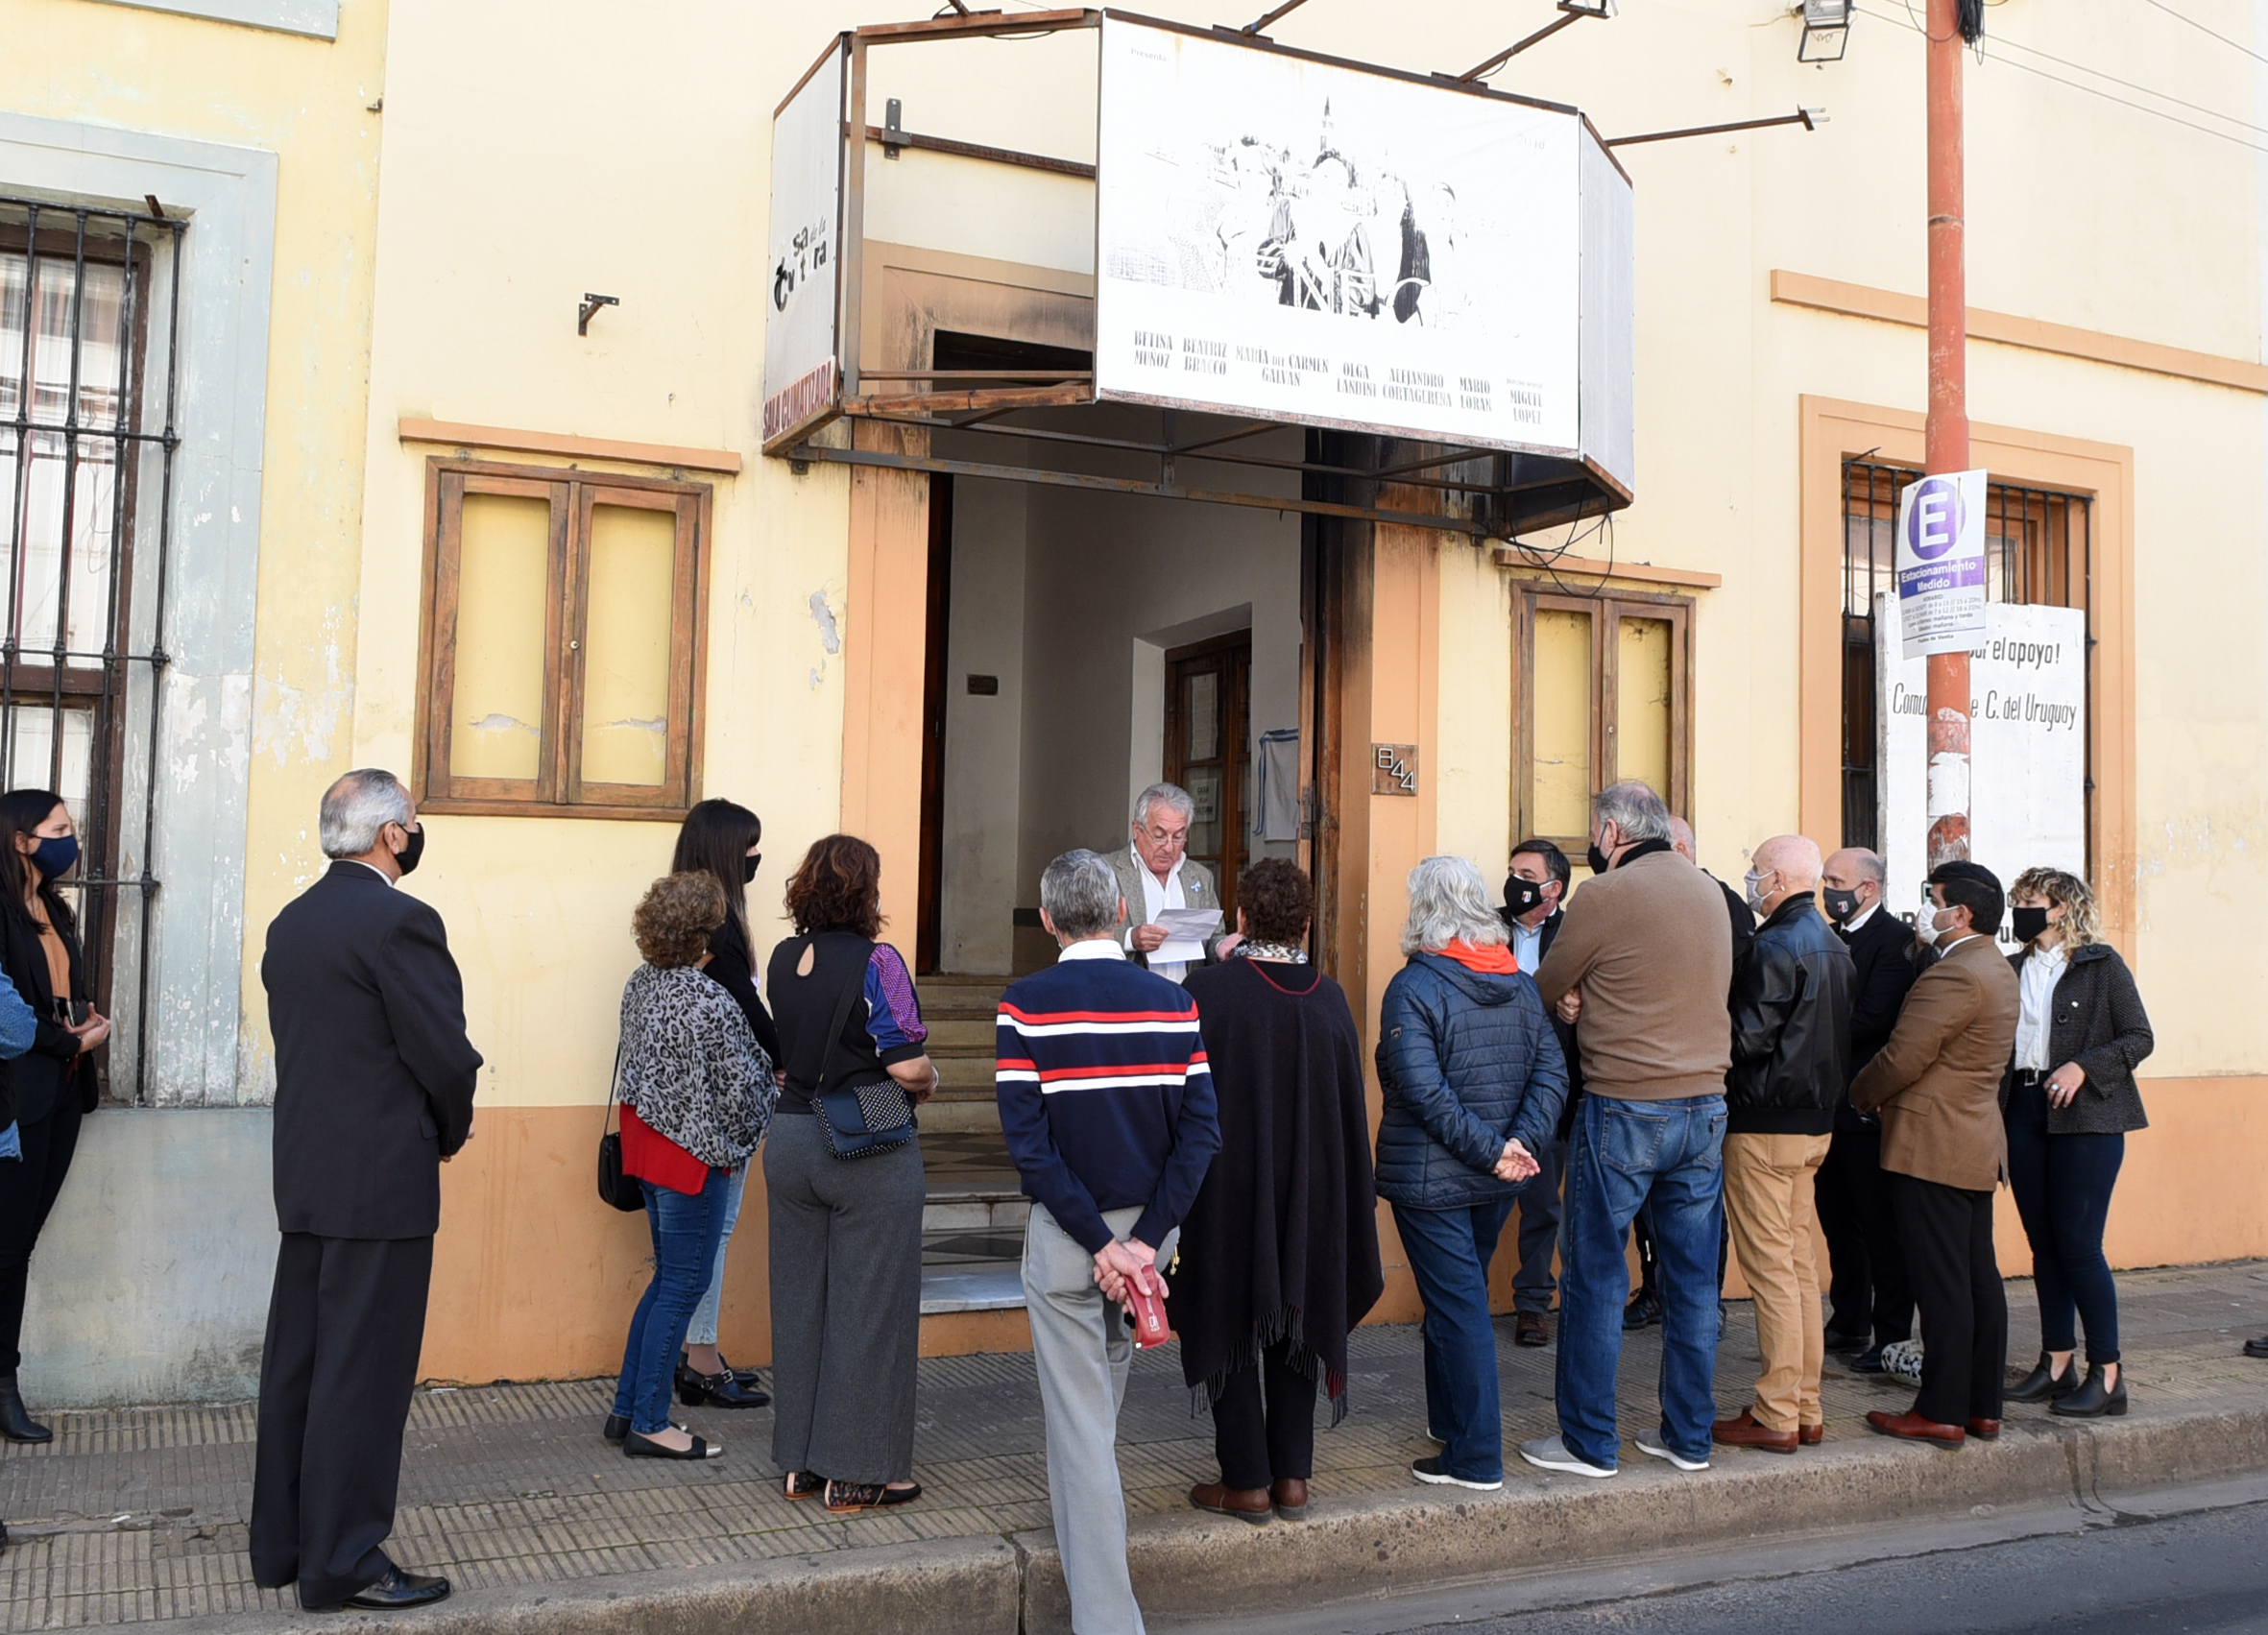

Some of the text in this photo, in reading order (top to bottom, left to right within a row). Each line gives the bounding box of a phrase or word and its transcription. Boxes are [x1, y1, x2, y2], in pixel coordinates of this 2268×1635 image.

[1134, 330, 1173, 350] BETINA
[1183, 337, 1228, 358] BEATRIZ
[1289, 353, 1330, 374] CARMEN
[1134, 349, 1227, 376] MUÑOZ BRACCO
[1337, 378, 1377, 397] LANDINI
[1342, 361, 1369, 380] OLGA
[1389, 367, 1444, 389] ALEJANDRO
[1460, 375, 1491, 395] MARIO
[763, 360, 832, 443] SALA CLIMATIZADA
[1509, 389, 1544, 408] MIGUEL
[1918, 492, 1949, 549] E
[1901, 561, 1977, 584] Estacionamiento
[1917, 578, 1950, 592] Medido
[1992, 636, 2007, 661] el
[2008, 641, 2061, 670] apoyo!
[1985, 689, 1999, 720] C.
[2003, 696, 2021, 721] del
[1378, 747, 1416, 791] 844
